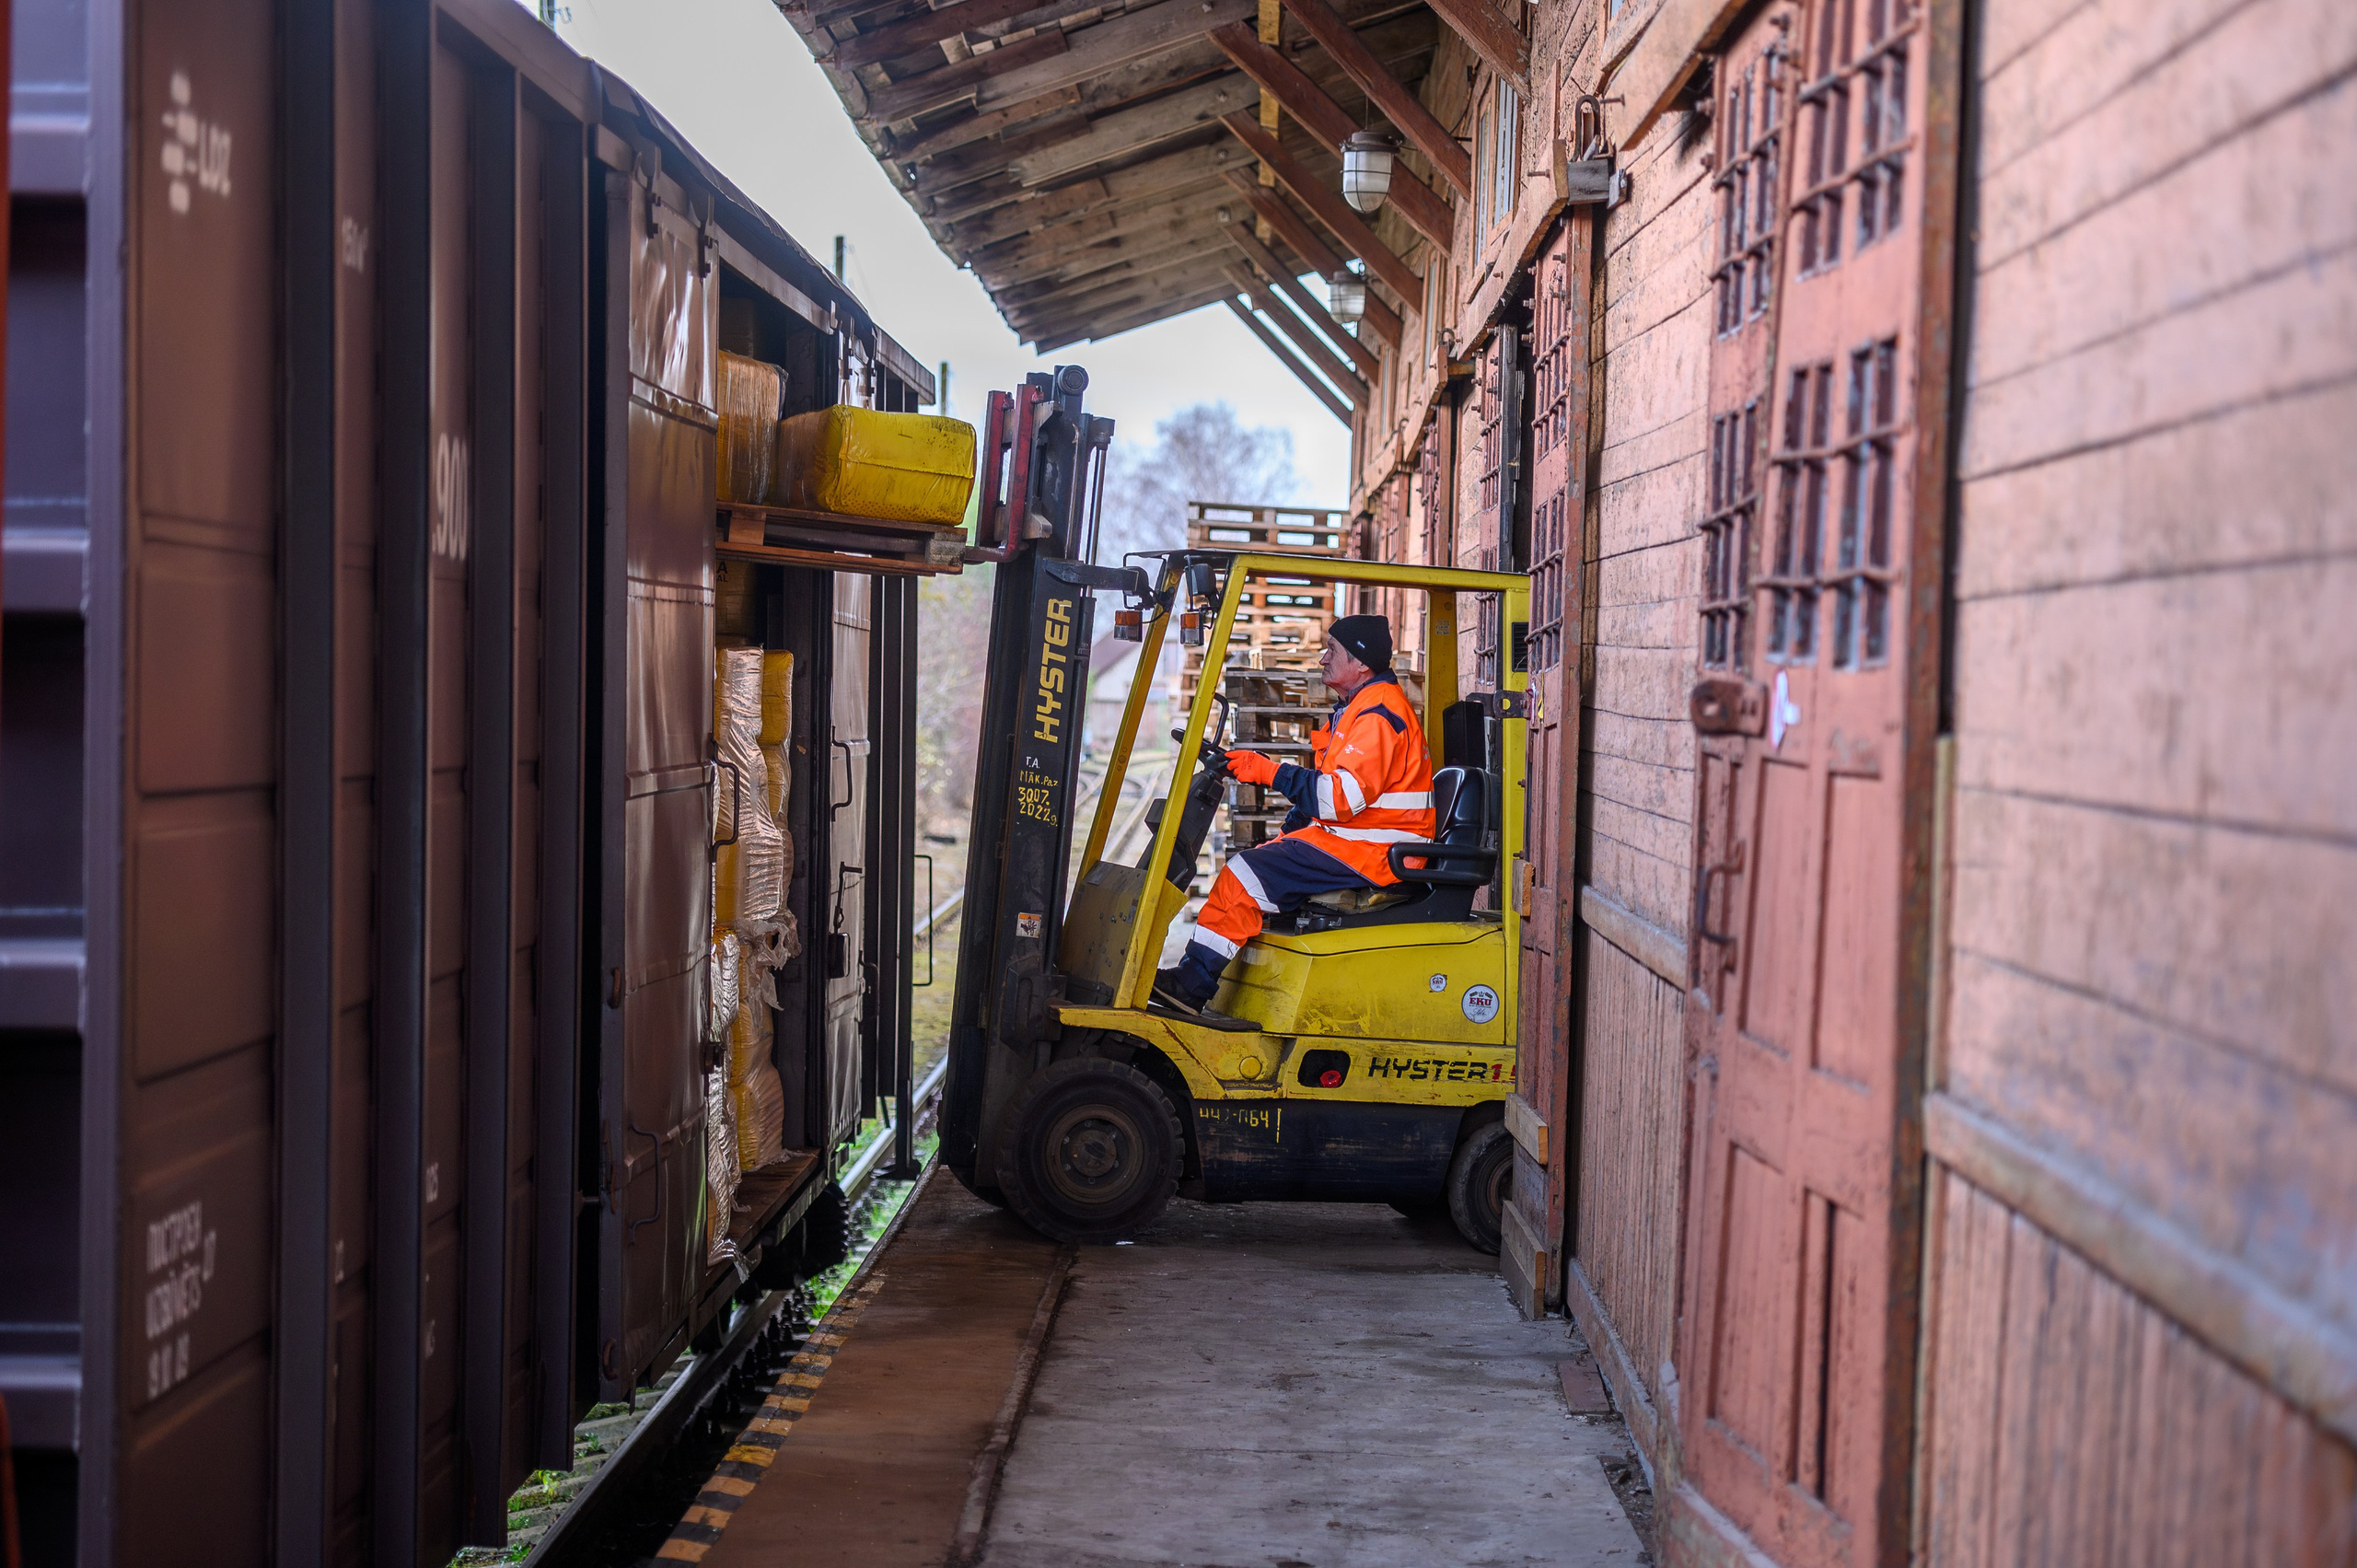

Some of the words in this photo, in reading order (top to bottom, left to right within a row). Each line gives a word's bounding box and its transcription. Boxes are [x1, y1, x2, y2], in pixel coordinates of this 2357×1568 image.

[1034, 598, 1073, 744] HYSTER
[1469, 997, 1492, 1006] EKU
[1367, 1057, 1488, 1082] HYSTER
